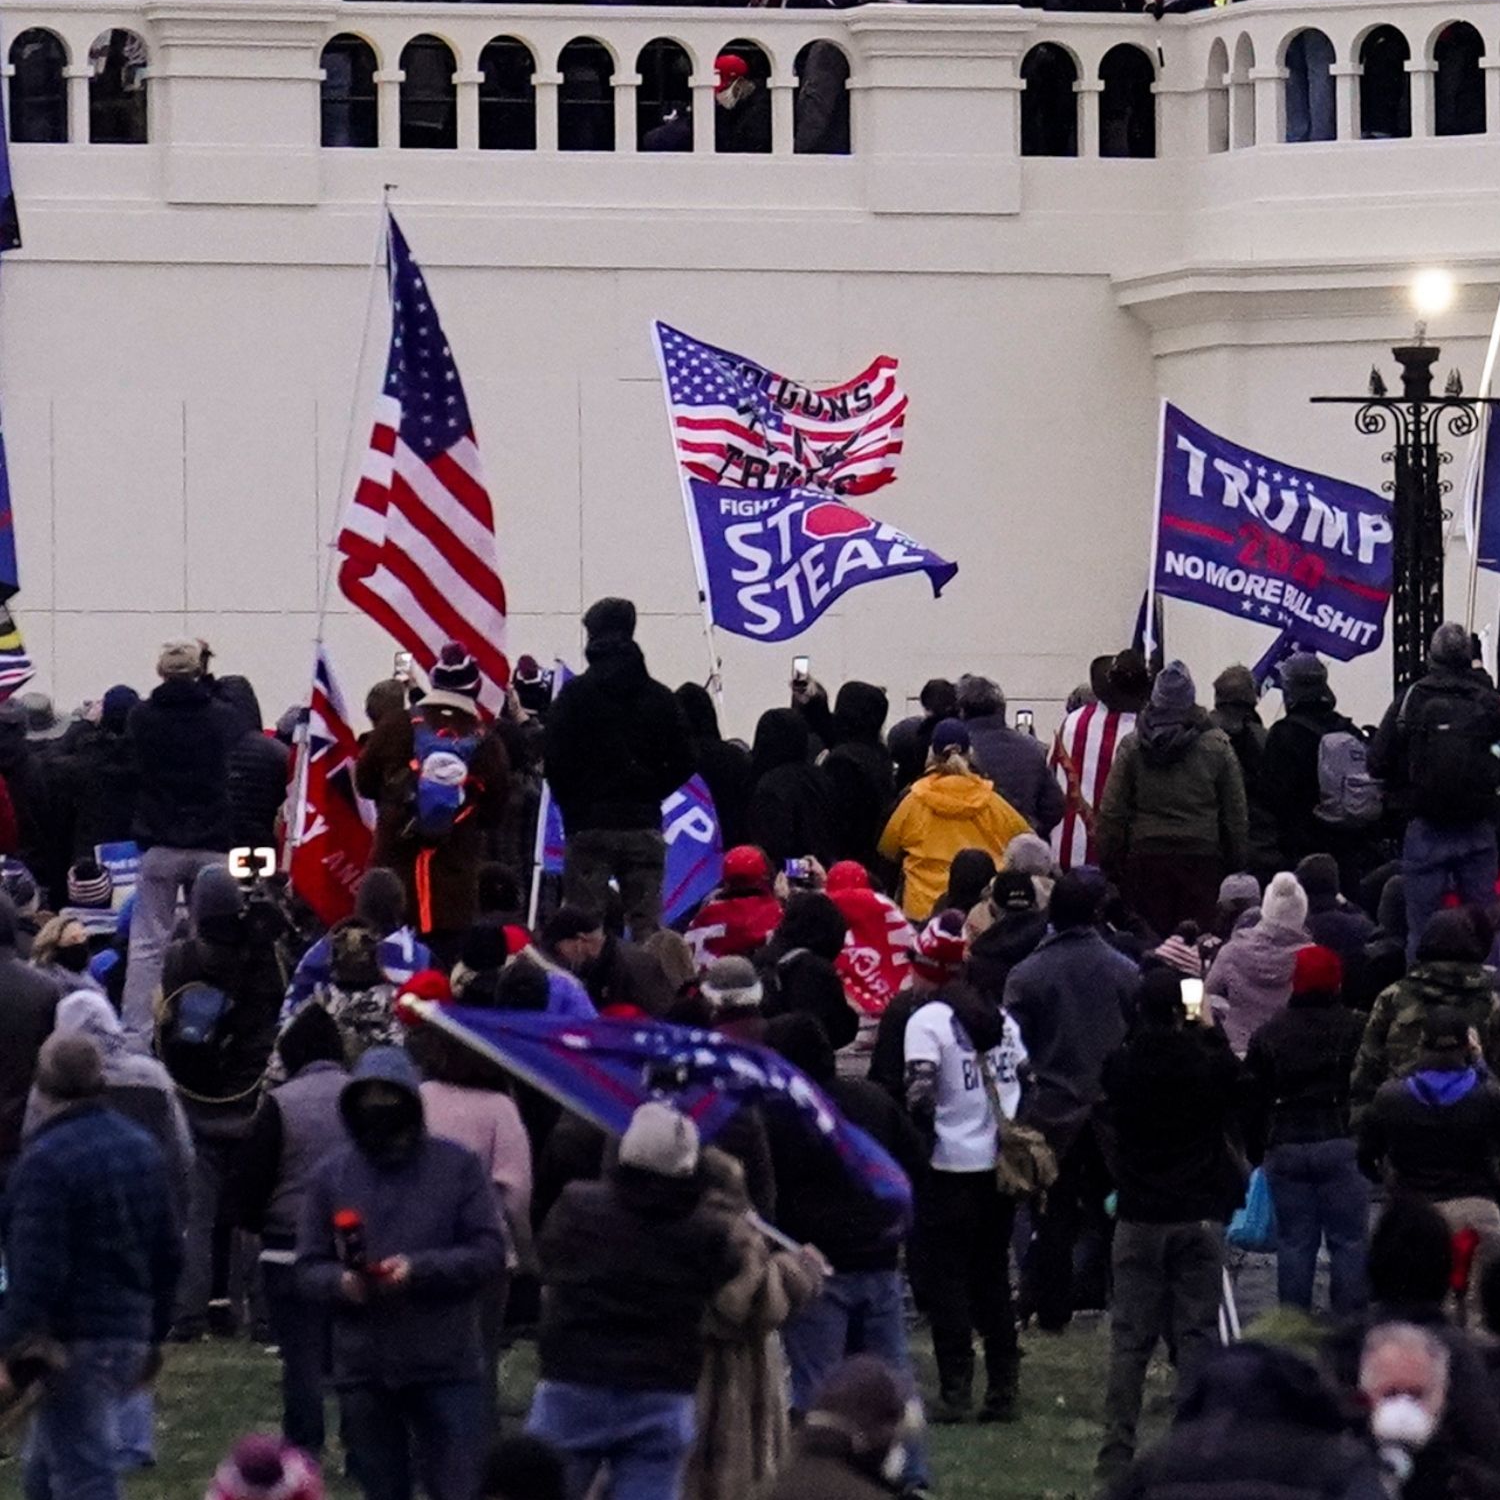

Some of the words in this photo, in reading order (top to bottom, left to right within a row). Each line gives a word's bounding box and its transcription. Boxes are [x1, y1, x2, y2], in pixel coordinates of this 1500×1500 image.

[773, 381, 873, 421] GUNS
[719, 497, 781, 517] FIGHT
[1176, 433, 1395, 565] TRUMP
[737, 538, 925, 636] STEAL
[1164, 550, 1206, 581] NO
[1205, 560, 1284, 605] MORE
